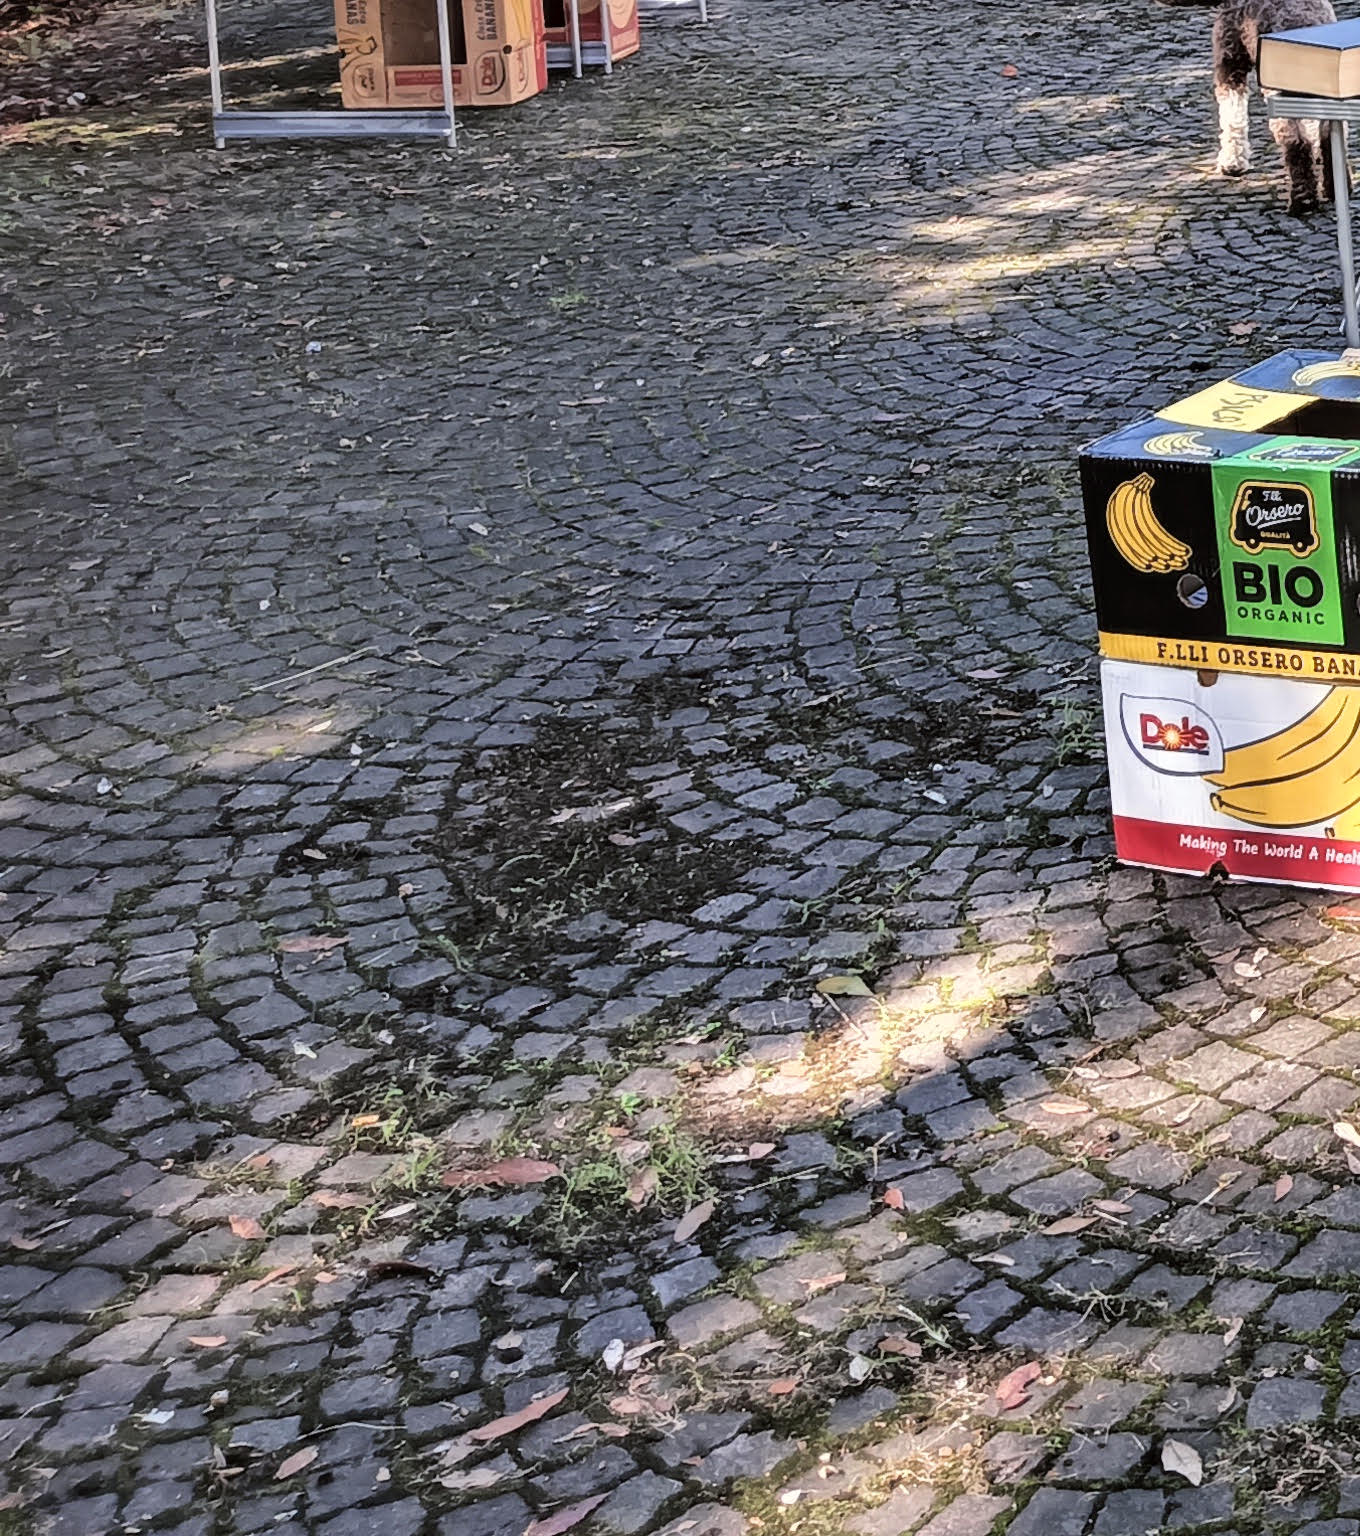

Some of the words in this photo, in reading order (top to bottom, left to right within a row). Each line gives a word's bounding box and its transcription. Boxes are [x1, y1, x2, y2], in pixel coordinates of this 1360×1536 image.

[482, 57, 497, 86] Dole
[1246, 503, 1305, 526] Orsero
[1233, 561, 1324, 608] BIO
[1237, 606, 1325, 625] ORGANIC
[1156, 643, 1209, 663] F.LLI
[1218, 647, 1303, 671] ORSERO
[1140, 712, 1210, 751] Dole
[1180, 833, 1227, 856] Making
[1233, 839, 1259, 855] The
[1264, 842, 1303, 860] World
[1308, 846, 1319, 861] A
